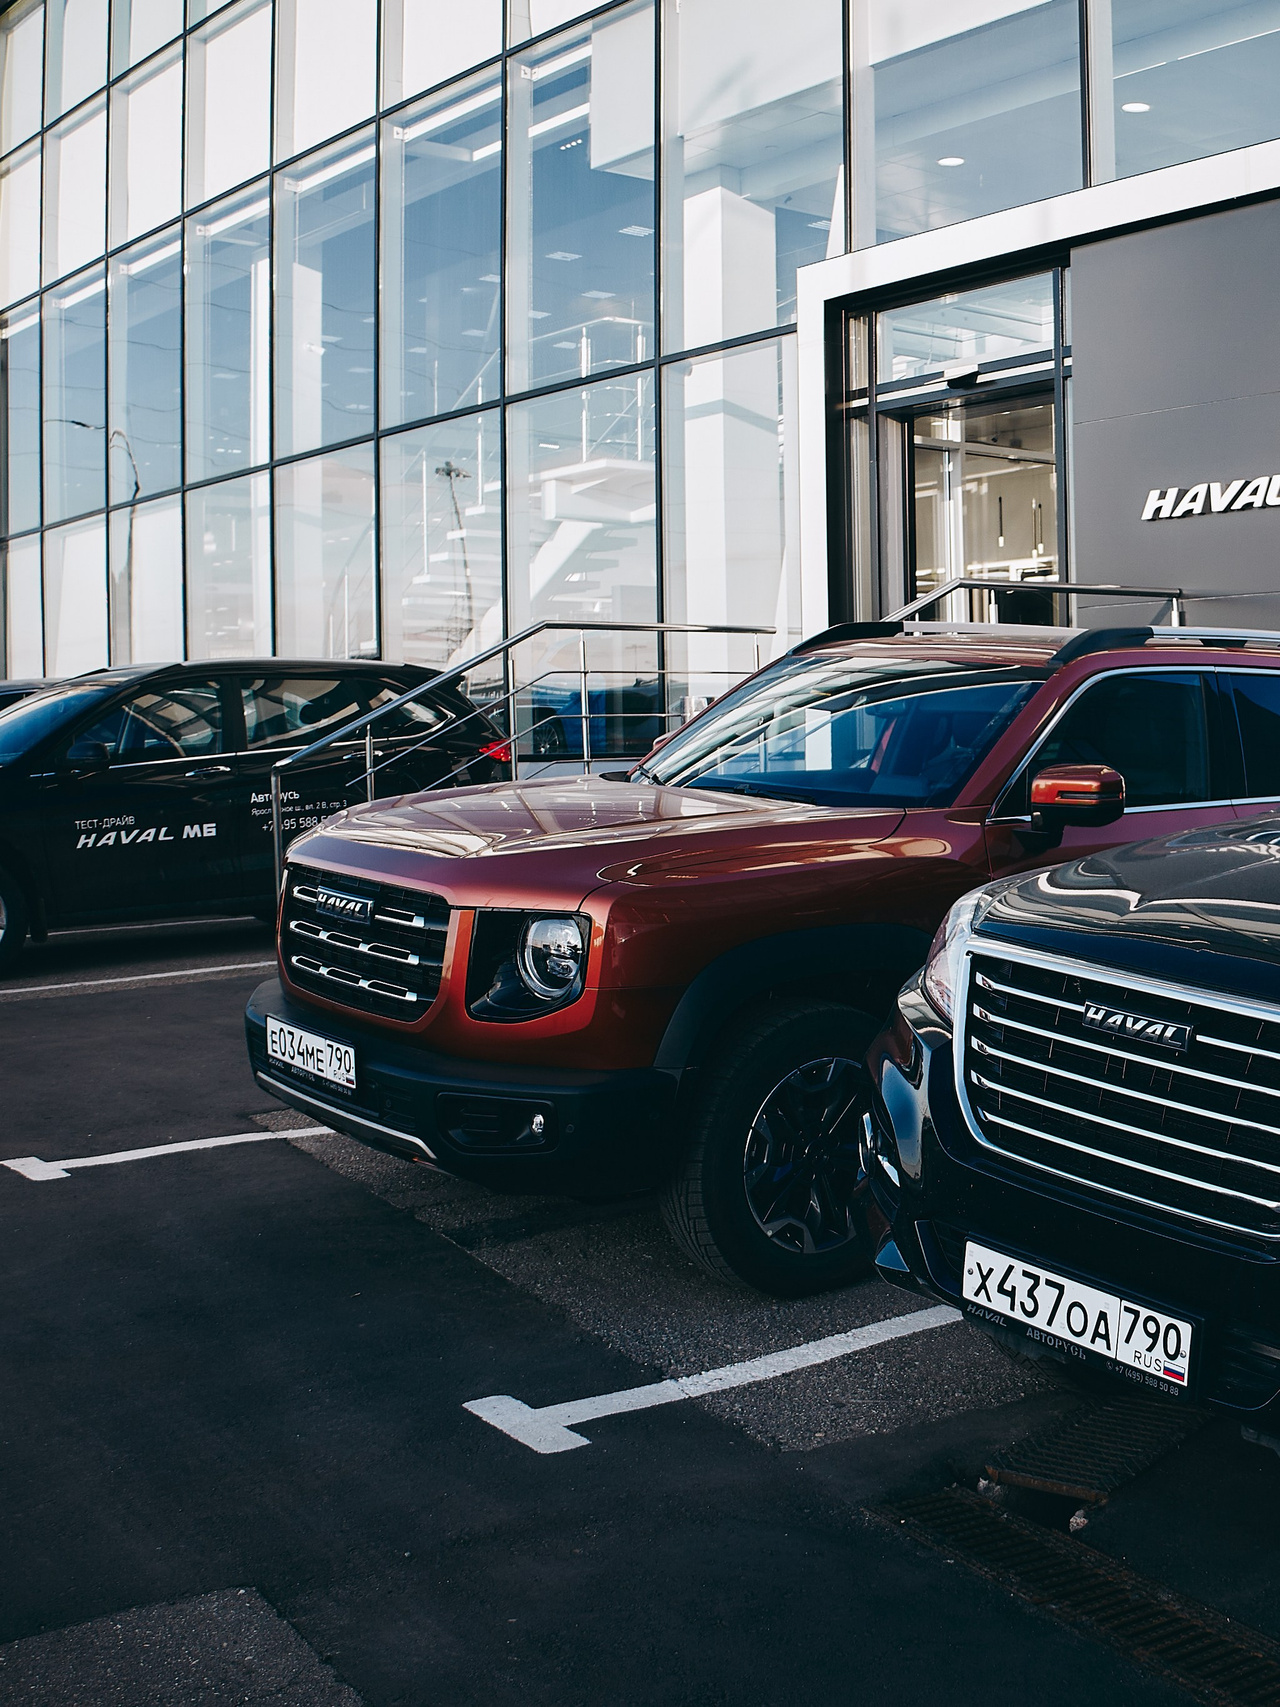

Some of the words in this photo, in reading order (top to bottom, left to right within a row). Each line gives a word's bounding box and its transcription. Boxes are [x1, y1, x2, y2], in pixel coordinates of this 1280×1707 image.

[316, 801, 320, 809] 2
[75, 815, 135, 830] ТЕСТ-ДРАЙВ
[76, 826, 174, 849] HAVAL
[317, 893, 365, 918] HAVAL
[1085, 1006, 1182, 1046] HAVAL
[327, 1043, 351, 1073] 790
[333, 1069, 346, 1081] RUS
[966, 1303, 1007, 1327] HAVAL
[1026, 1327, 1086, 1360] АВТОРУСЬ
[1123, 1305, 1182, 1361] 790
[1133, 1350, 1162, 1372] RUS
[1145, 1375, 1158, 1388] 588
[1160, 1381, 1169, 1392] 50
[1169, 1385, 1179, 1396] 88
